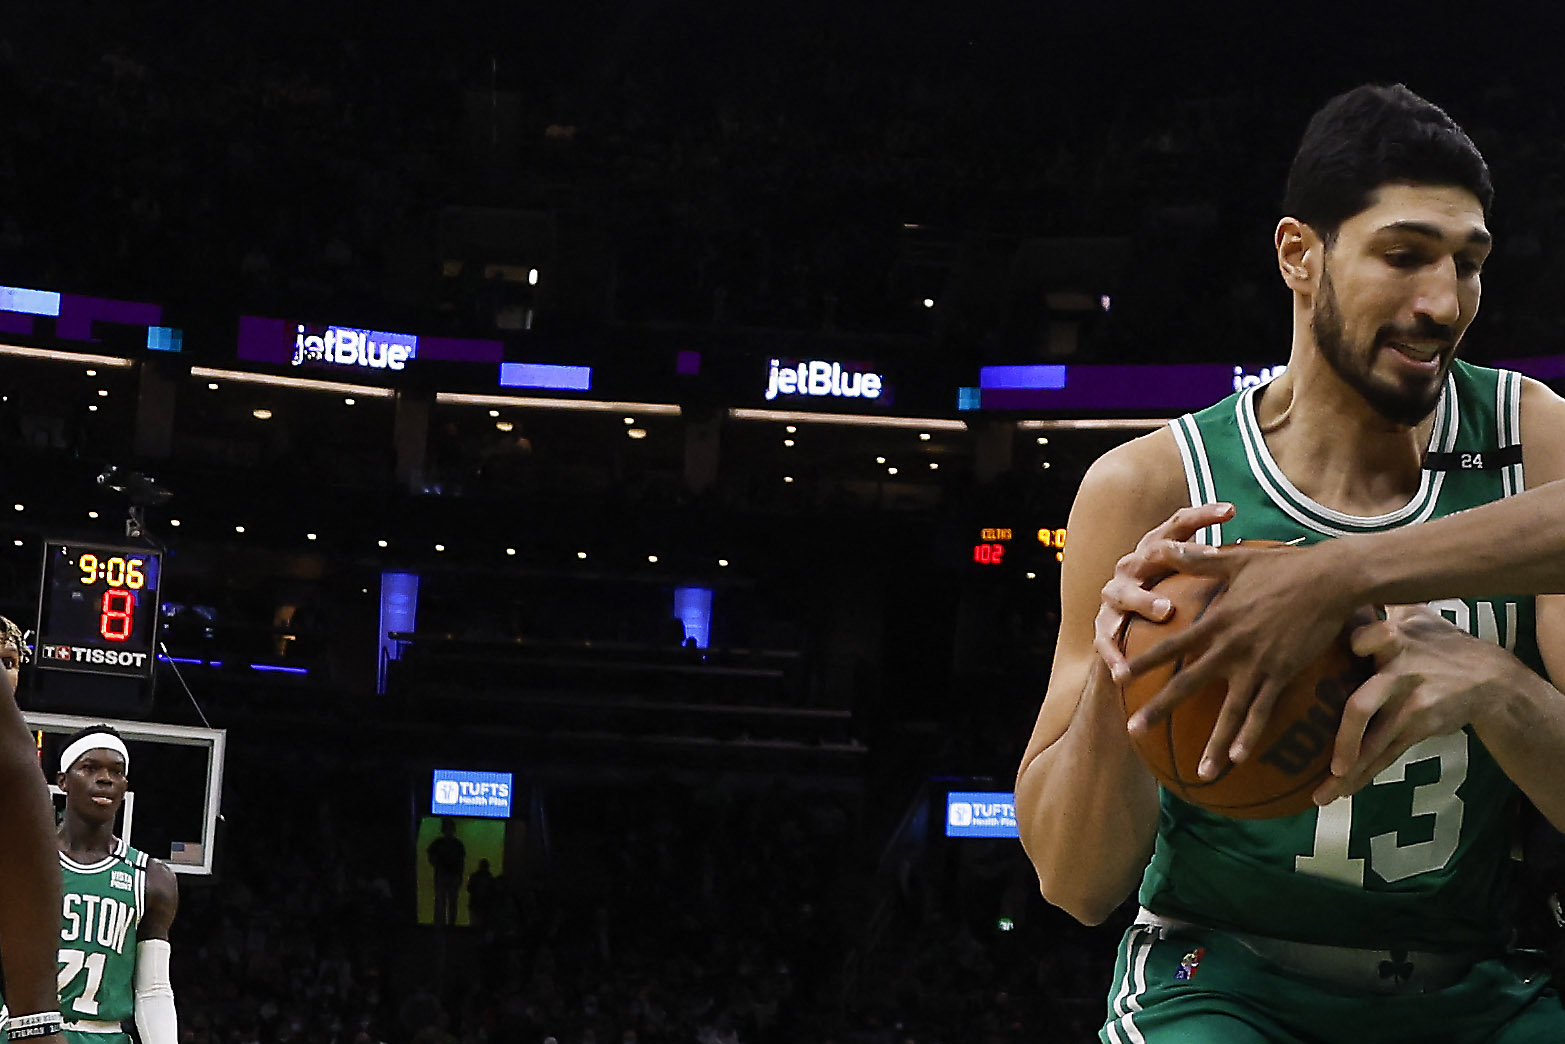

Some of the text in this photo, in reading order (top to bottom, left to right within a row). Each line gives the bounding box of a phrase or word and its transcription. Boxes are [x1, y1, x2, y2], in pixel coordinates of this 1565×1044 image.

[291, 324, 406, 370] jetBlue
[765, 359, 881, 400] jetBlue
[1461, 453, 1483, 469] 24
[974, 543, 1004, 564] 102
[1038, 528, 1067, 548] 9:0
[79, 553, 146, 590] 9:06
[100, 588, 136, 642] 8
[71, 647, 147, 667] TISSOT
[459, 781, 509, 797] TUFTS
[1295, 730, 1469, 888] 13
[60, 893, 135, 955] STON
[57, 950, 106, 1016] 71
